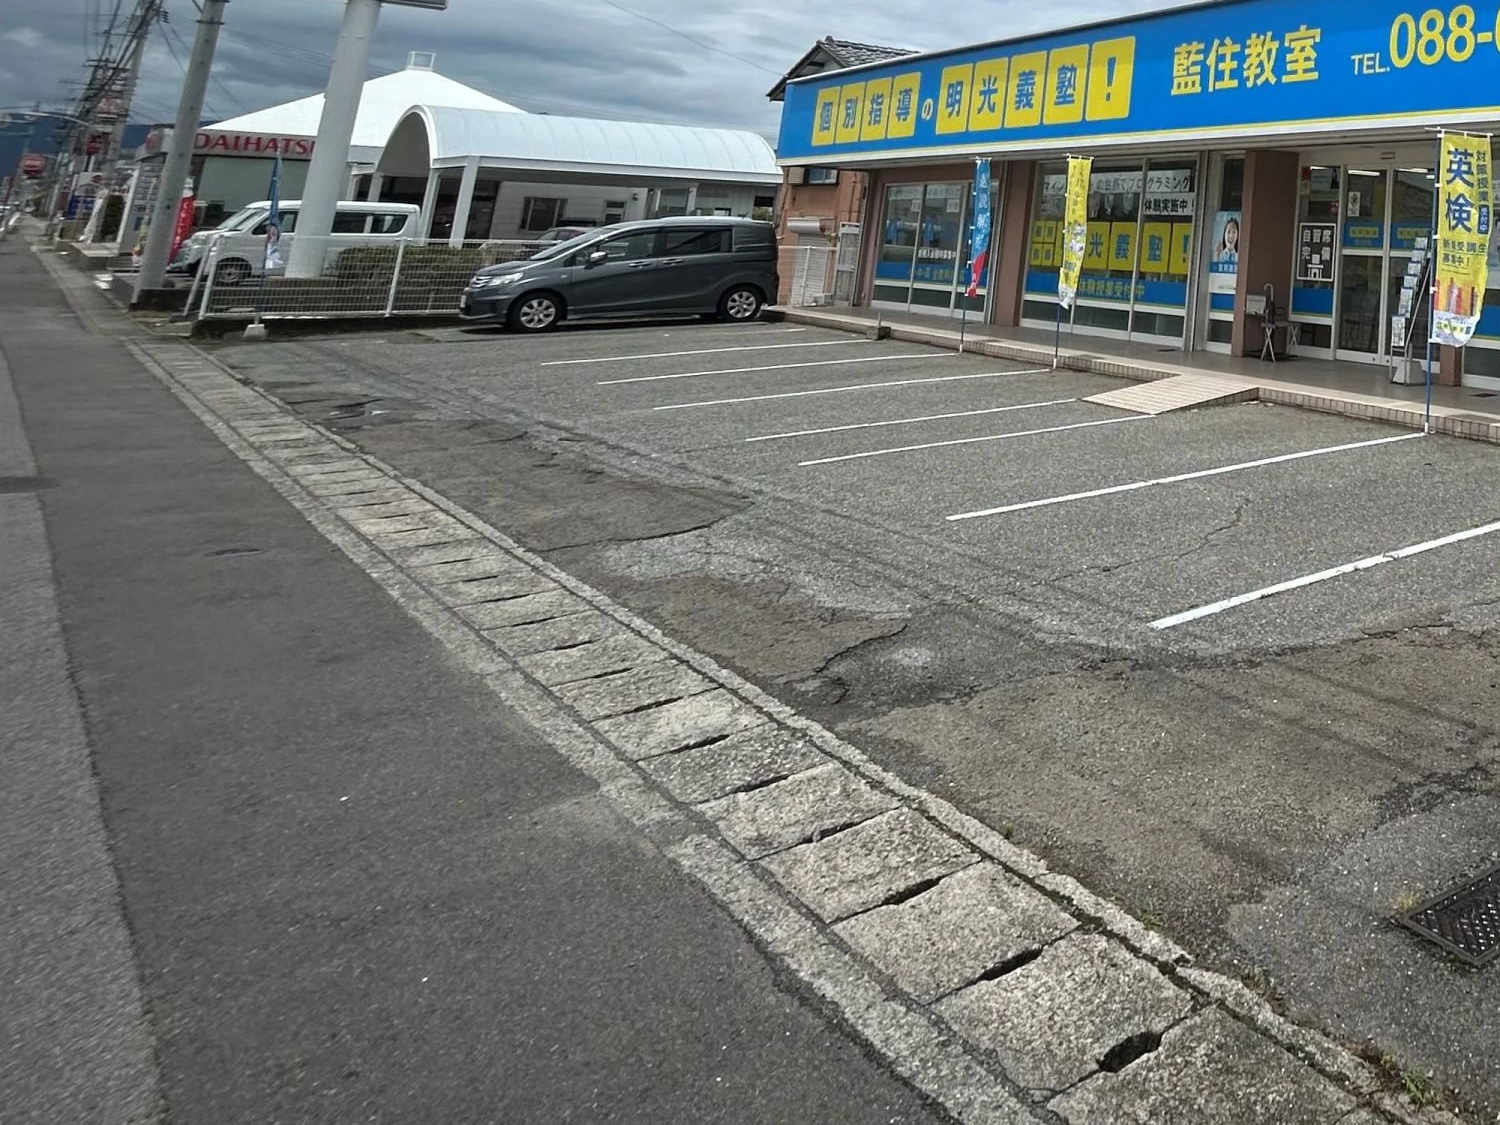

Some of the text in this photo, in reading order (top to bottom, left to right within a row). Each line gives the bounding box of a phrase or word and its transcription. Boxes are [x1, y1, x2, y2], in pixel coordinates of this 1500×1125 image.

[1171, 25, 1322, 96] 藍住教室
[1351, 53, 1390, 76] TEL.
[1445, 148, 1474, 233] 英検
[1088, 233, 1189, 263] 光義塾!
[1302, 229, 1332, 243] 自習席
